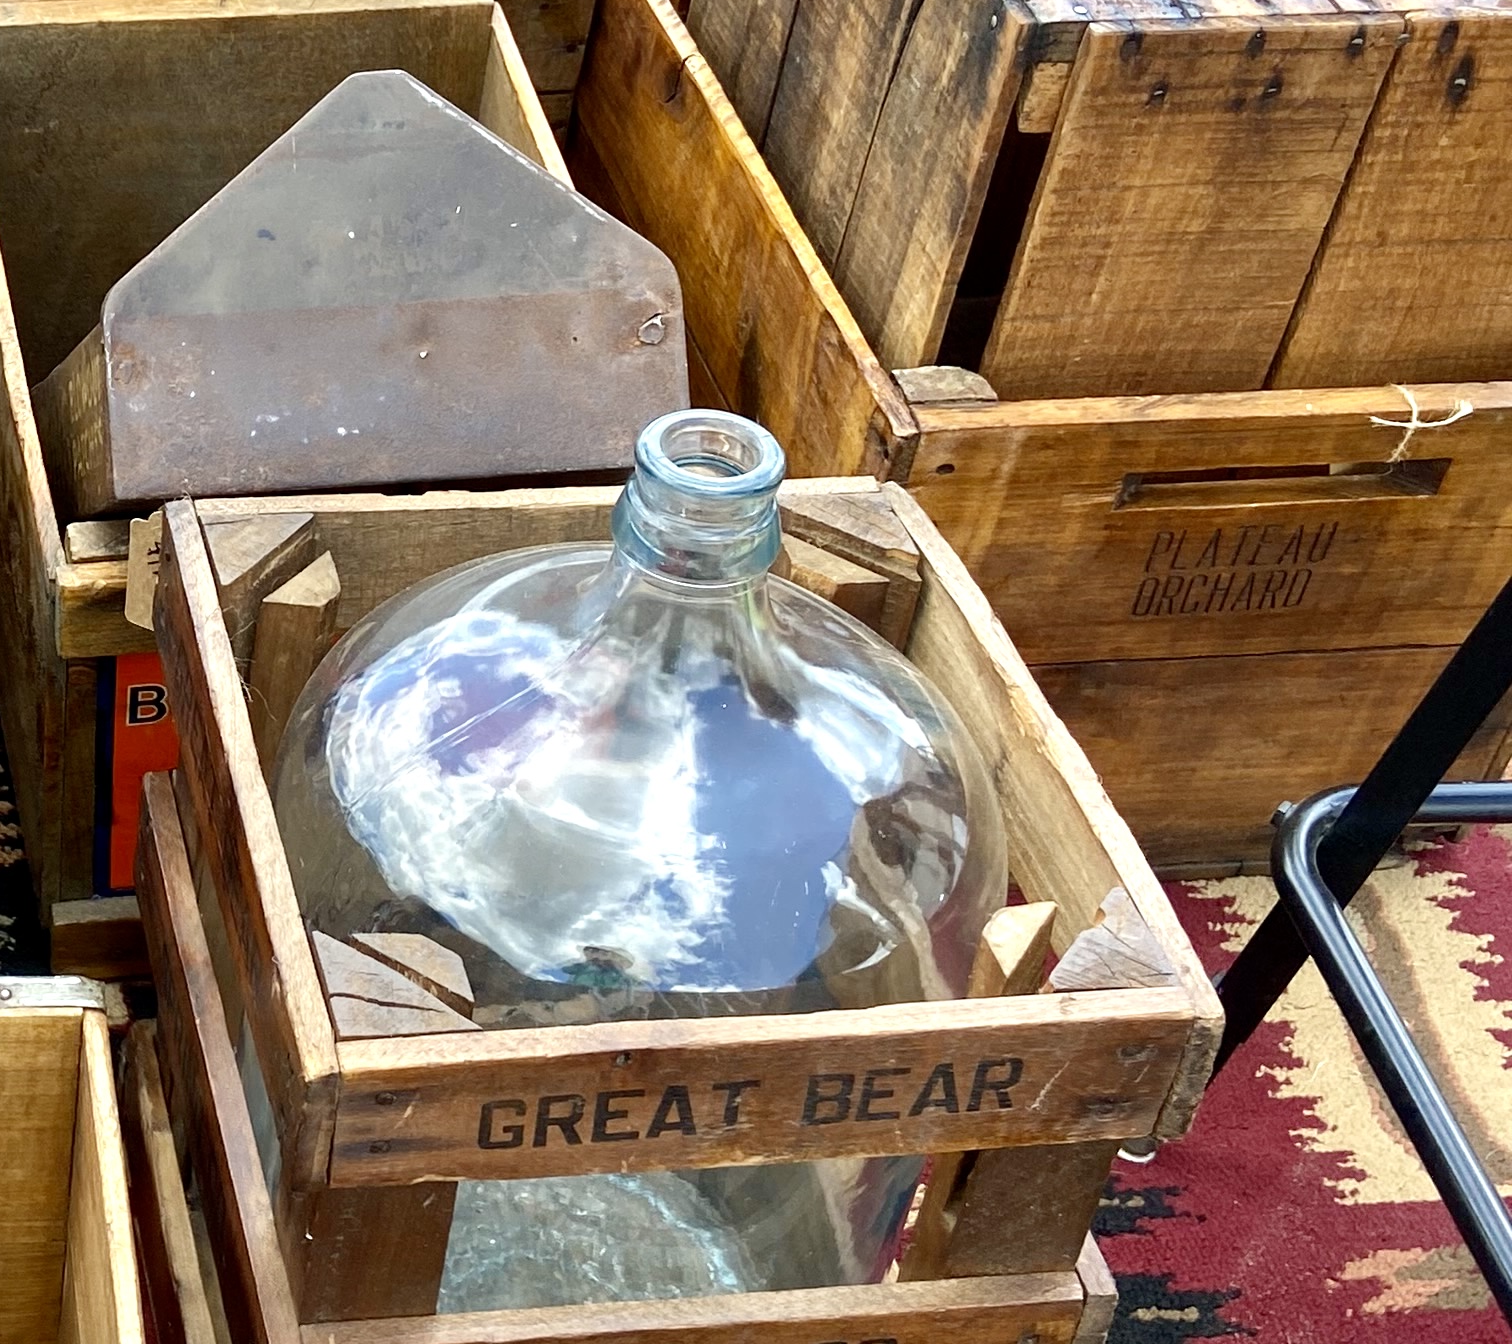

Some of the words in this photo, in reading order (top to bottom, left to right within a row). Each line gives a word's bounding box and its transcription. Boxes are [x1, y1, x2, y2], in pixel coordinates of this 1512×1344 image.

[1143, 522, 1338, 573] PLATEAU
[1131, 568, 1313, 617] ORCHARD
[477, 1078, 761, 1151] GREAT
[800, 1056, 1024, 1126] BEAR
